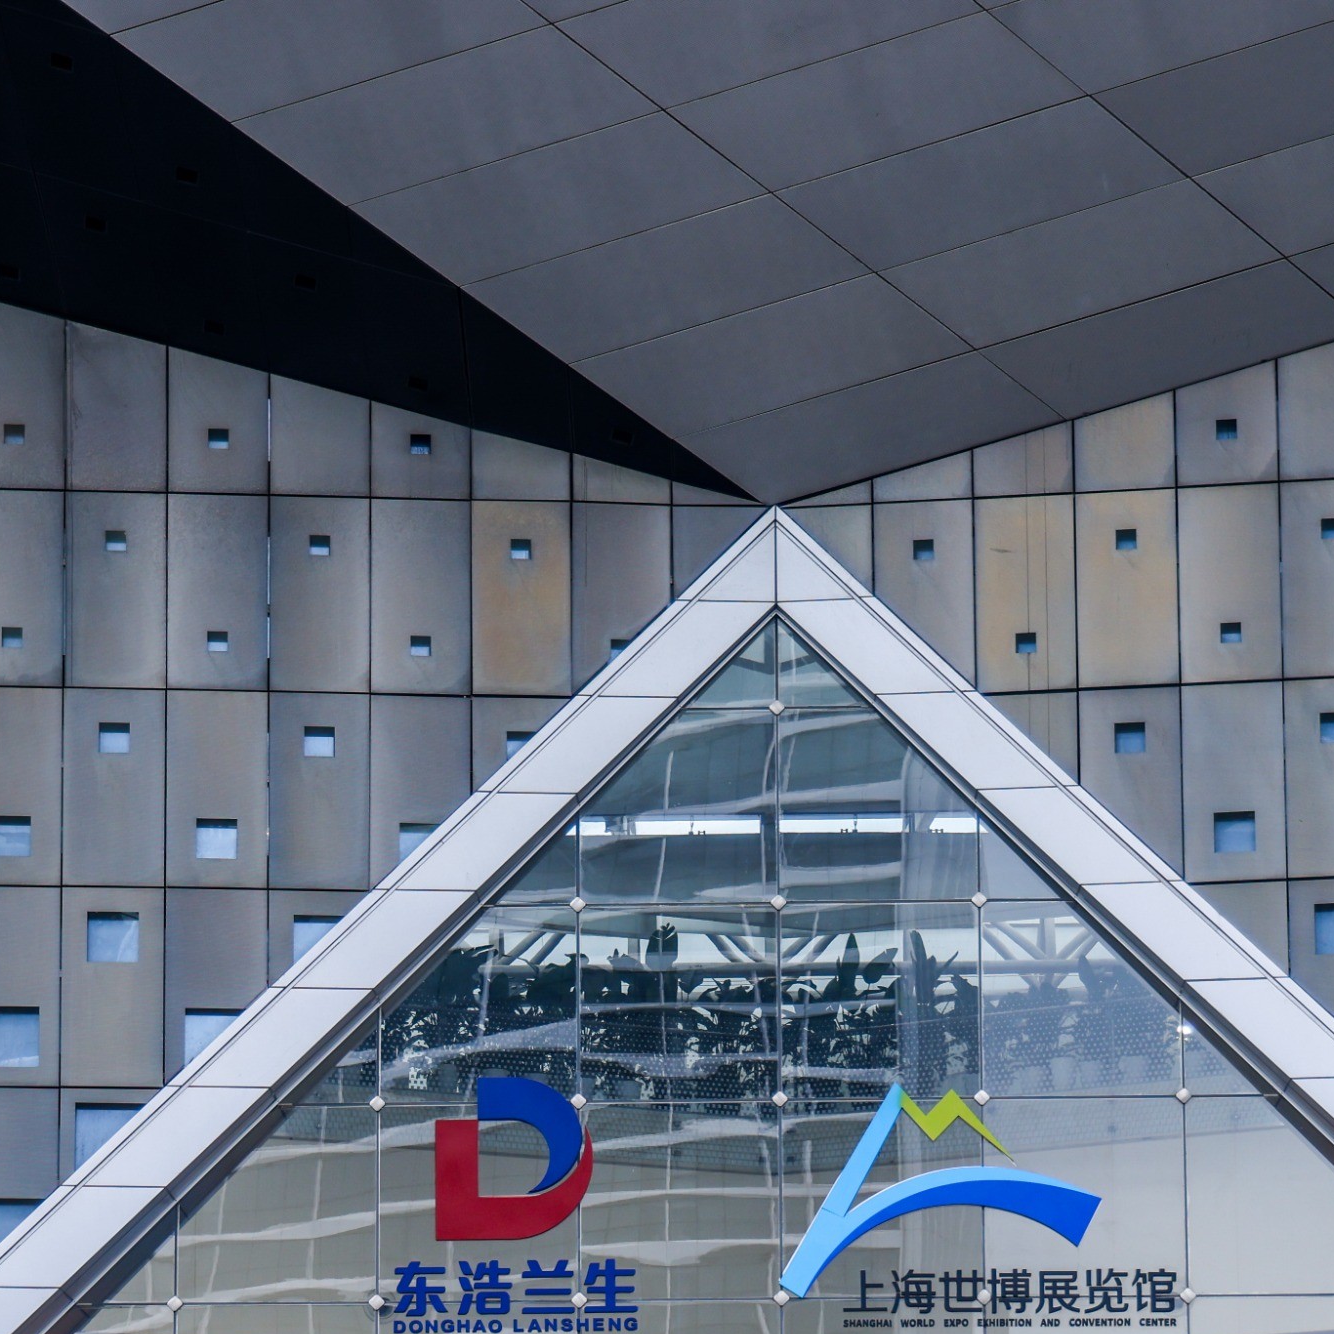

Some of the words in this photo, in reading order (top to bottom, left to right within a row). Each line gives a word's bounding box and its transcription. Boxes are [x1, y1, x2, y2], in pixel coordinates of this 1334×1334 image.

[394, 1259, 638, 1316] 东浩兰生
[844, 1269, 1176, 1313] 上海世博展览馆
[393, 1319, 502, 1334] DONGHAO
[513, 1316, 638, 1332] LANSHENG
[844, 1318, 892, 1328] SHANGHAI
[901, 1318, 935, 1328] WORLD
[945, 1318, 969, 1328] EXPO
[978, 1318, 1032, 1328] EXHIBITION
[1041, 1318, 1060, 1328] AND
[1070, 1318, 1131, 1328] CONVENTION
[1140, 1318, 1176, 1328] CENTER
